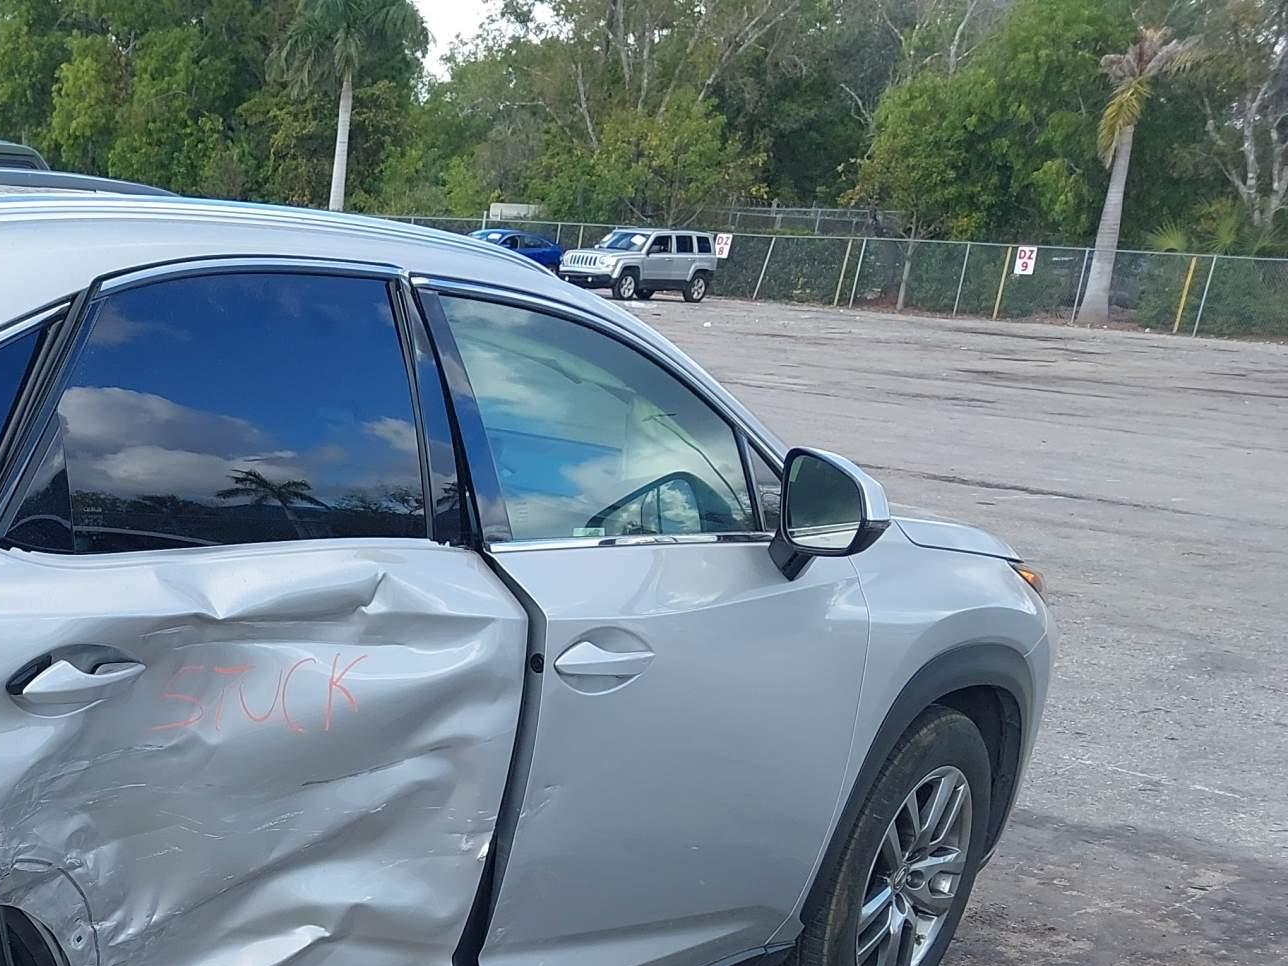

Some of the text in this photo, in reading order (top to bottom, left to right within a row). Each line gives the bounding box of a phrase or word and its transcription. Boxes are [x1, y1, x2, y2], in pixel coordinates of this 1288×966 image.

[717, 236, 730, 245] DZ
[718, 247, 724, 255] 8
[1018, 249, 1035, 260] DZ
[1021, 261, 1029, 271] 9
[151, 653, 367, 734] STUCK
